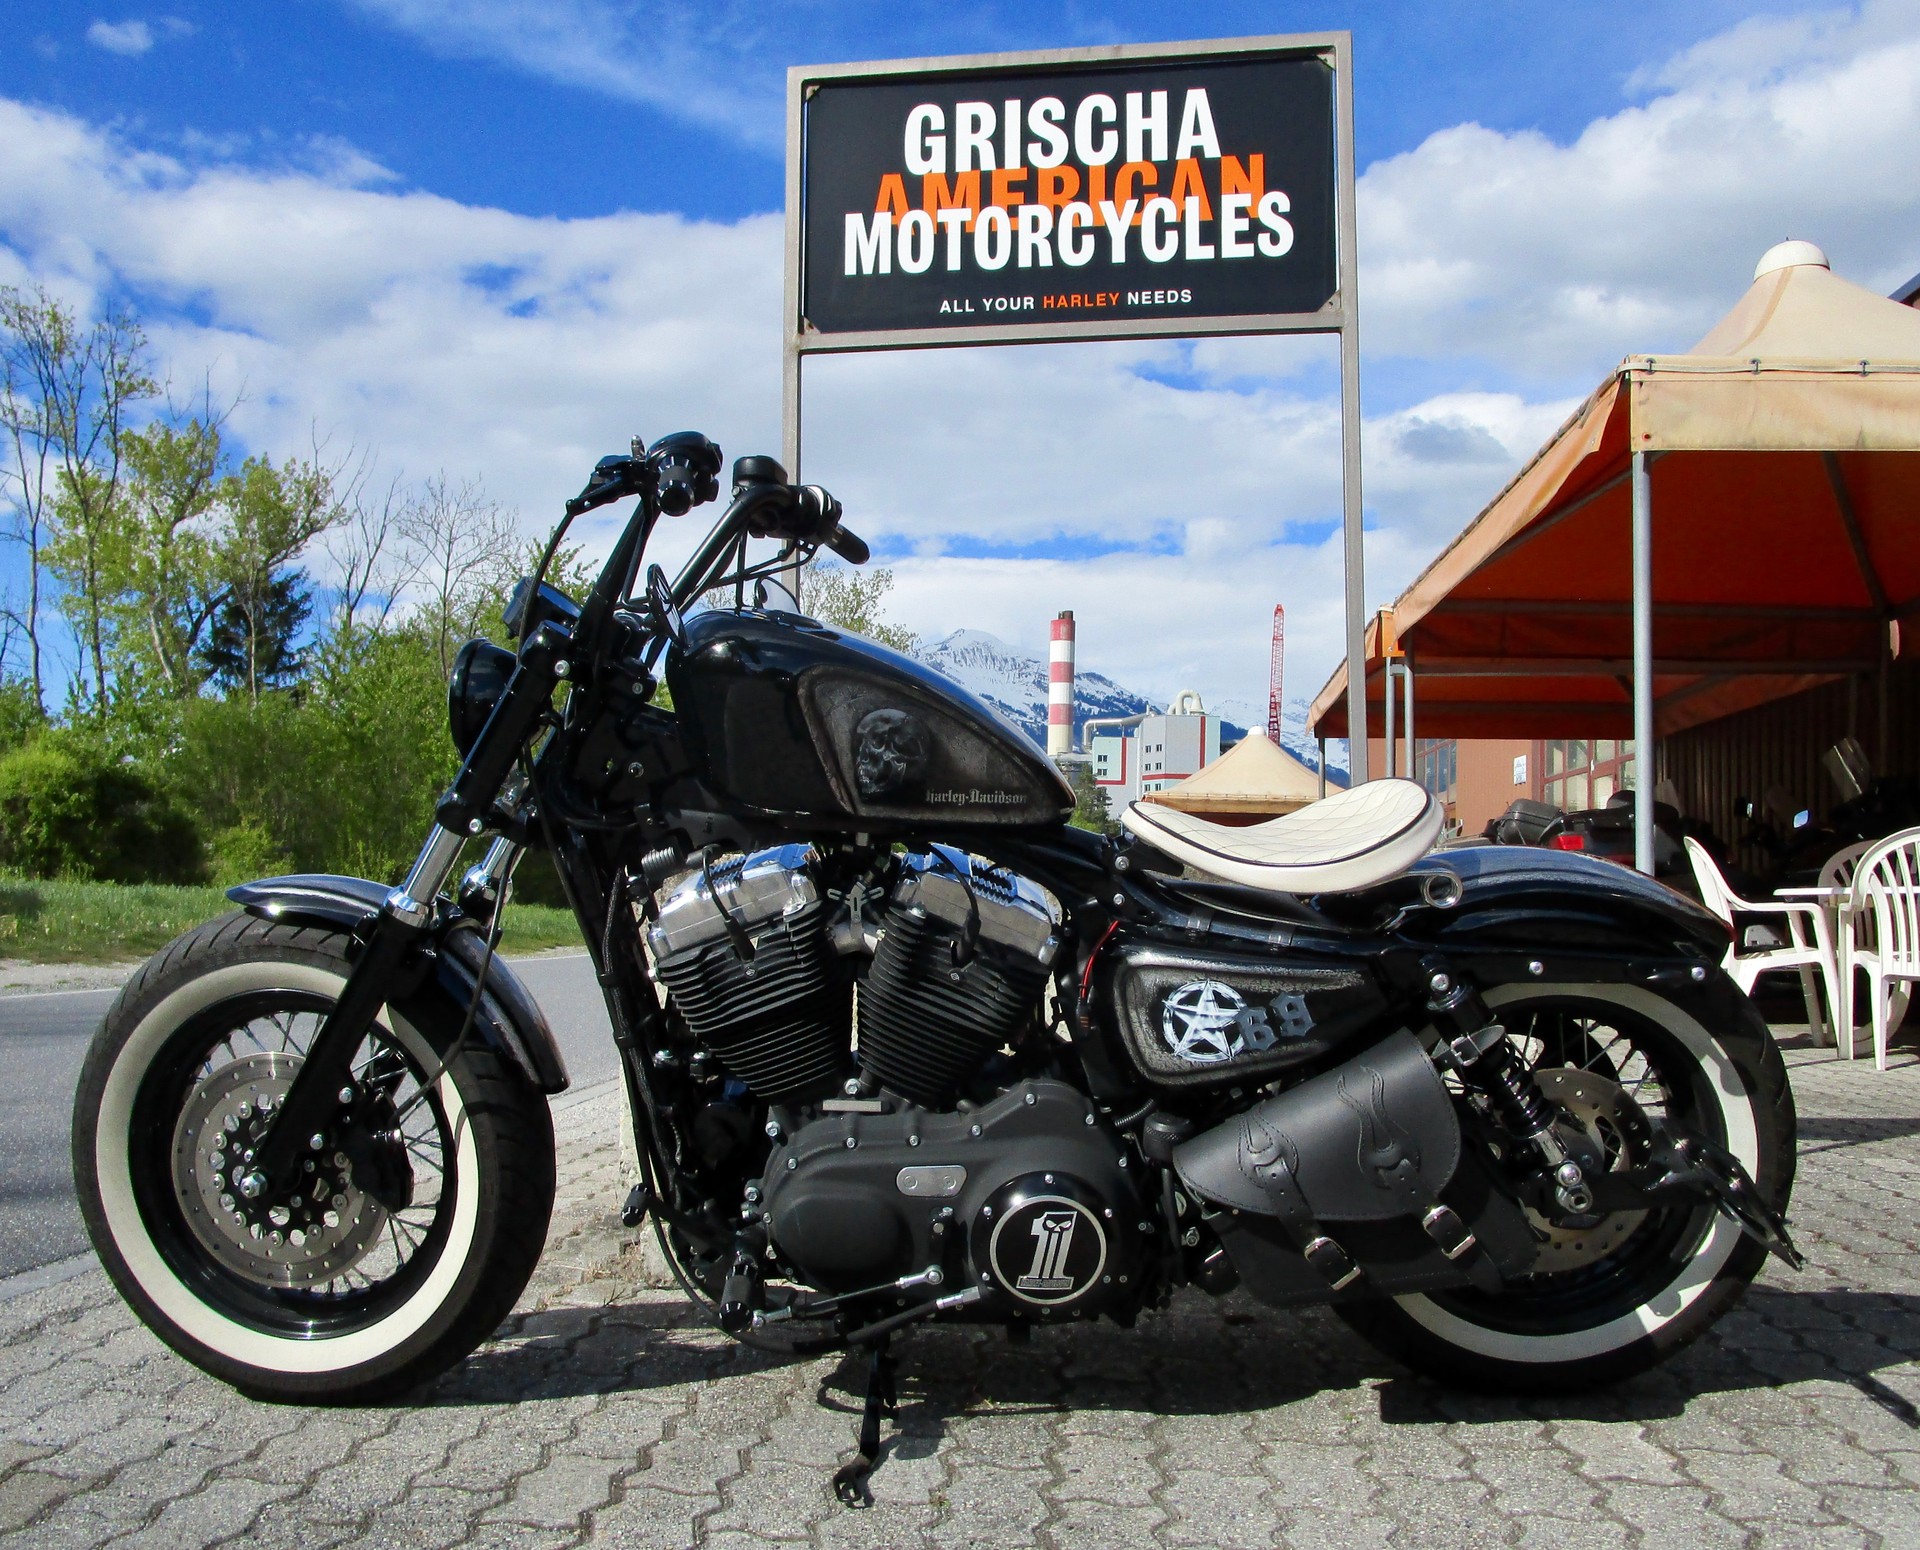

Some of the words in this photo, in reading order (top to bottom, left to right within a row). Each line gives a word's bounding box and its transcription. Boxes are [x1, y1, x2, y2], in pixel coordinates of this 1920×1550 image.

[903, 88, 1222, 176] GRISCHA
[844, 190, 1295, 276] MOTORCYCLES
[873, 153, 1266, 235] AMERICAN
[939, 299, 975, 314] ALL
[982, 296, 1035, 312] YOUR
[1043, 293, 1121, 309] HARLEY
[1127, 289, 1193, 305] NEEDS
